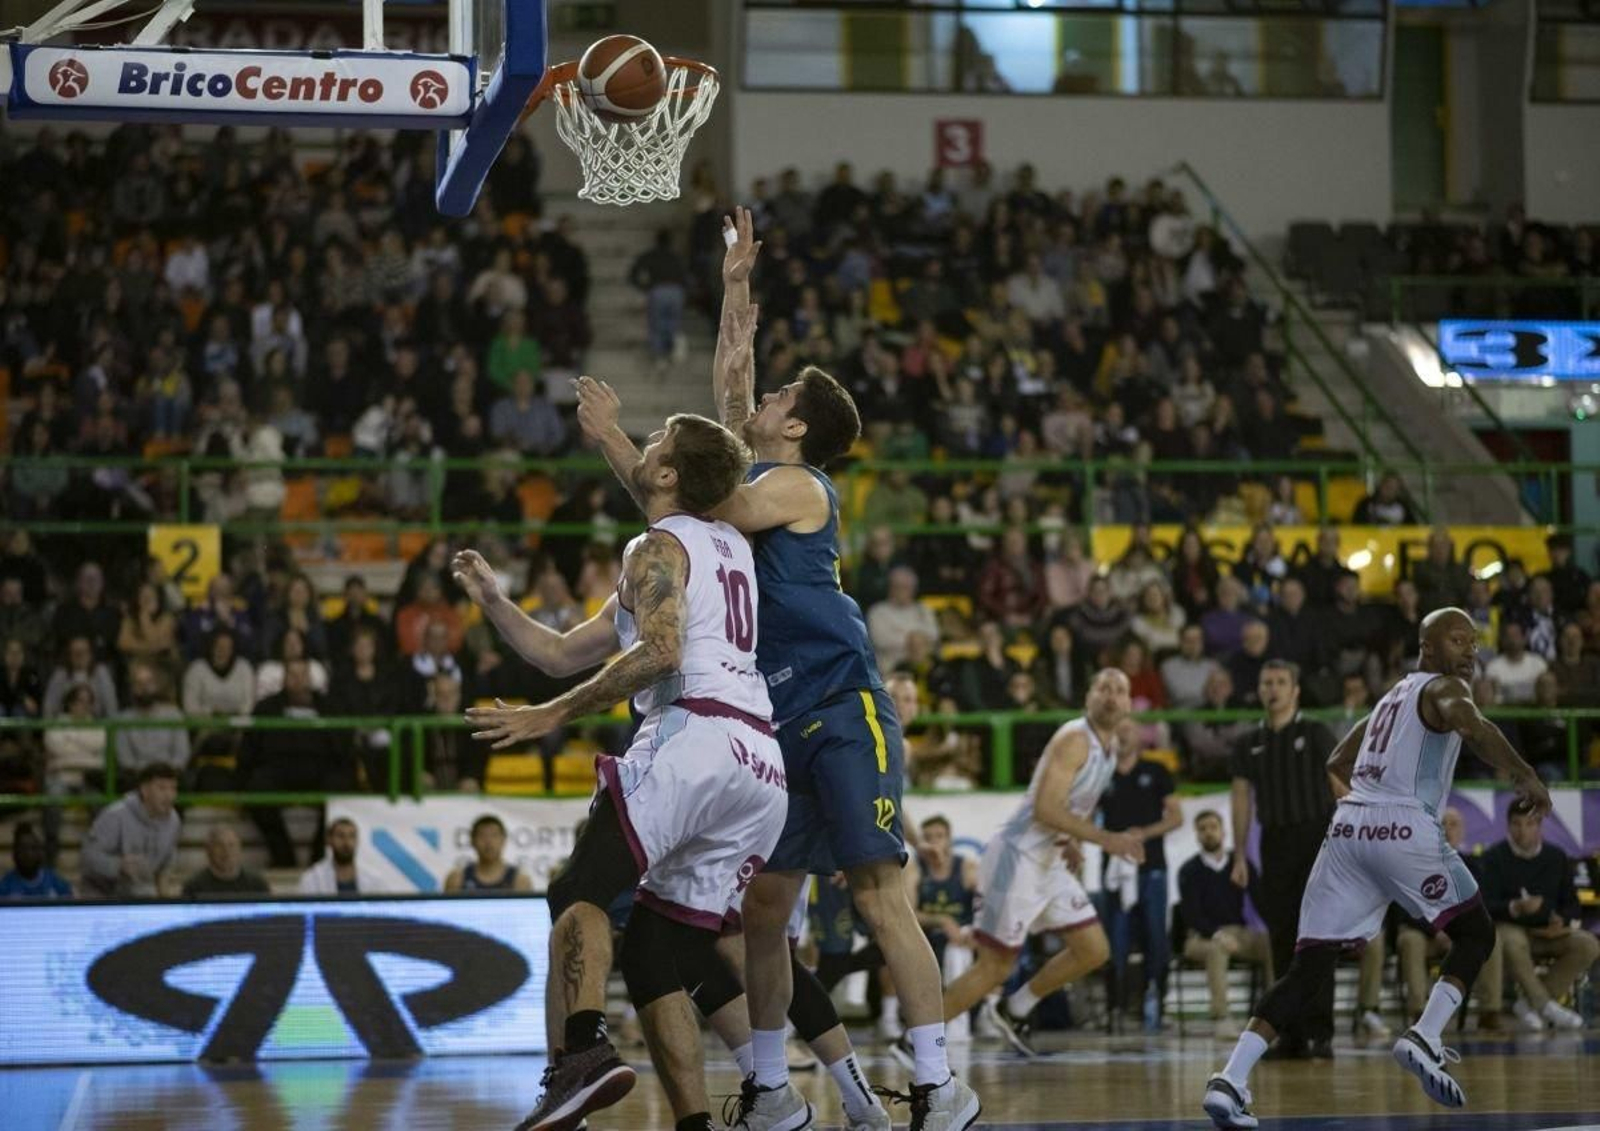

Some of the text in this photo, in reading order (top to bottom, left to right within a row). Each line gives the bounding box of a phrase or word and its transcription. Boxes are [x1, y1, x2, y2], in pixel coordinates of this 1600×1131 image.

[117, 60, 384, 103] BricoCentro
[943, 124, 972, 163] 3
[171, 537, 201, 583] 2
[715, 561, 754, 653] 10
[872, 796, 896, 833] 12
